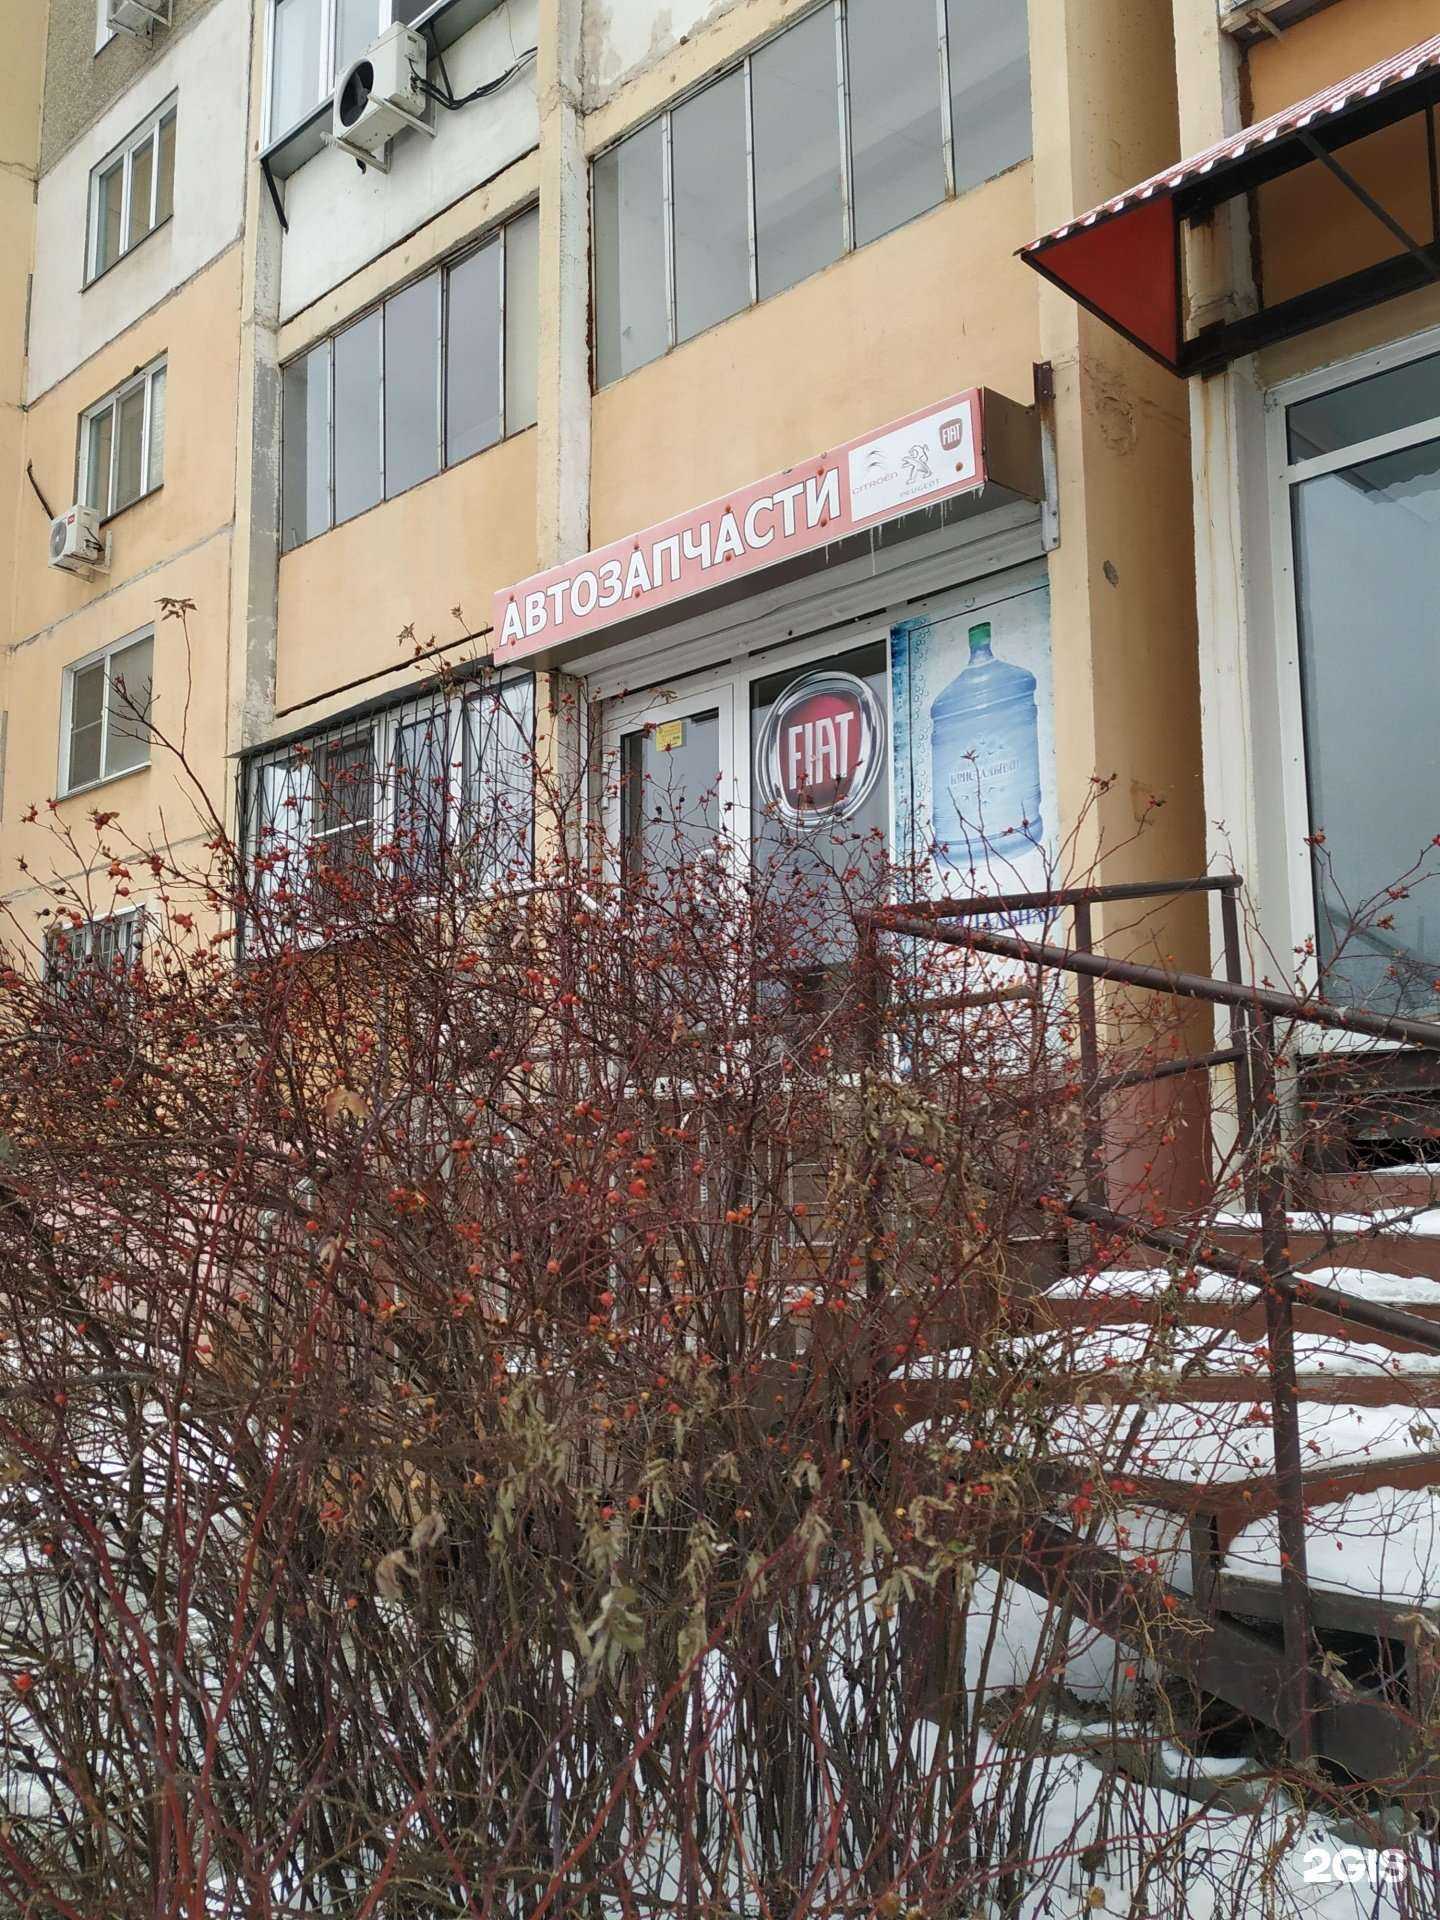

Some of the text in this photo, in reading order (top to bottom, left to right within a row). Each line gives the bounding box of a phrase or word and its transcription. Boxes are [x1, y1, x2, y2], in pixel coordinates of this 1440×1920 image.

[942, 423, 962, 446] FIAT
[499, 467, 841, 647] АВТОЗАПЧАСТИ
[788, 711, 854, 790] FIAT
